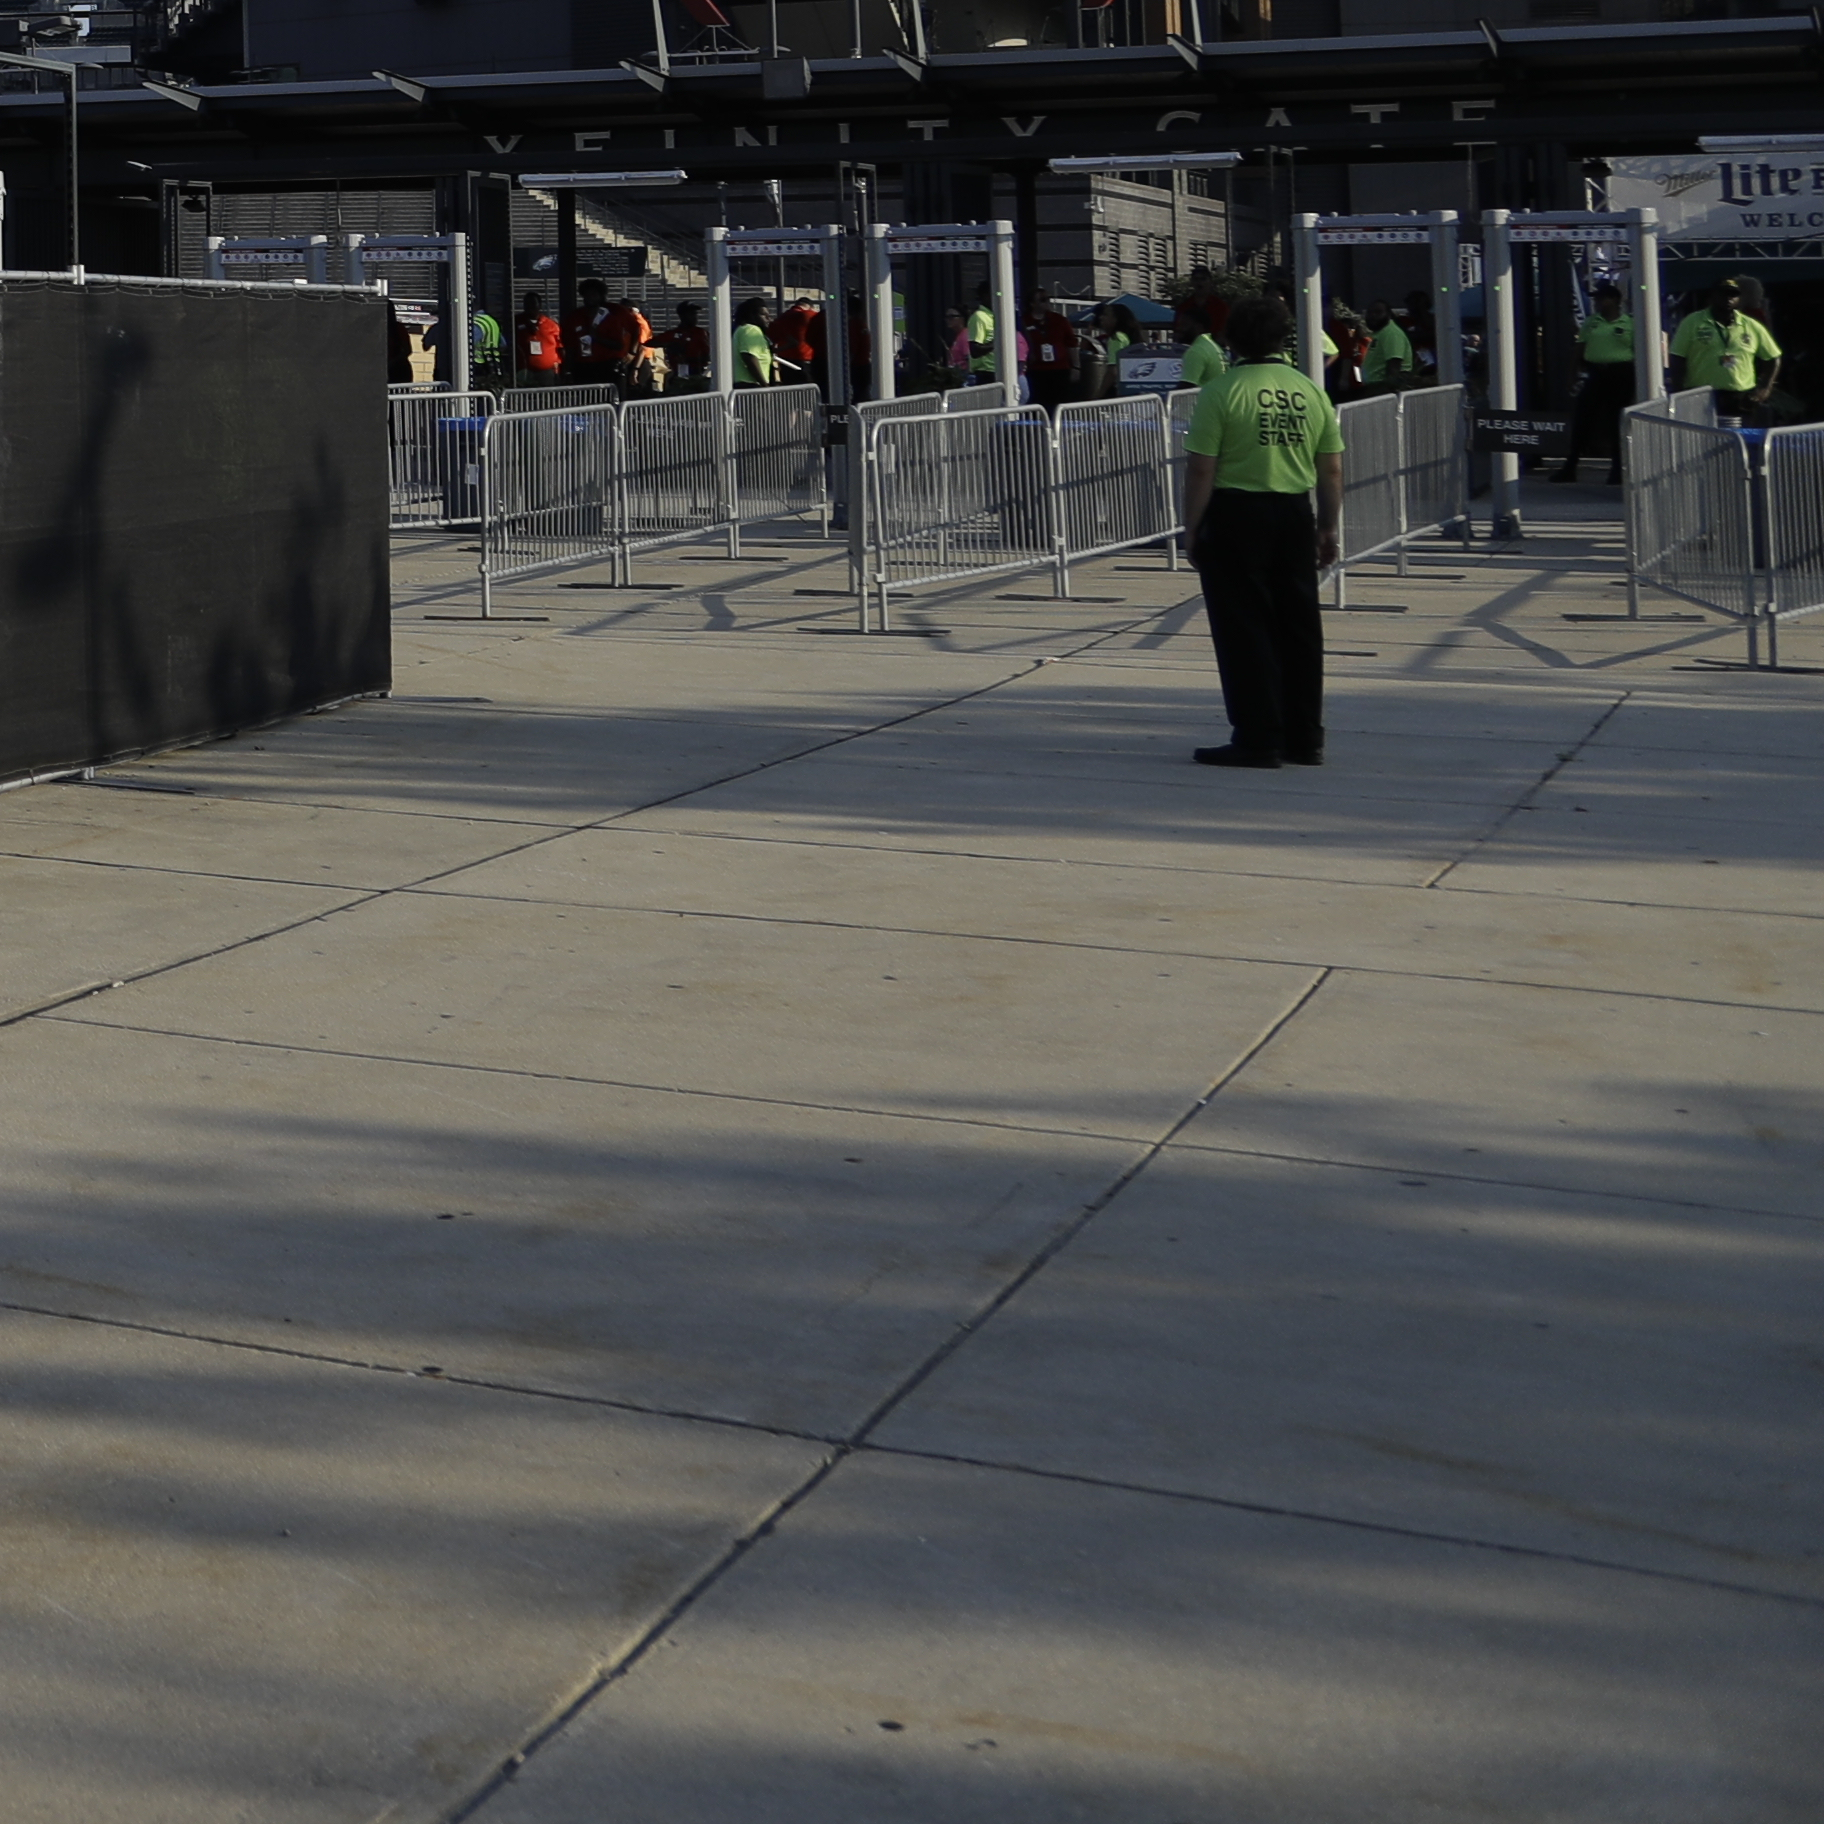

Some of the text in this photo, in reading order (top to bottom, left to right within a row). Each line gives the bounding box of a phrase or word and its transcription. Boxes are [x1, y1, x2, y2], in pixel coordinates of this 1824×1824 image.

[1716, 162, 1802, 207] Lite
[1257, 389, 1307, 412] CSC
[1258, 412, 1306, 429] EVENT
[1477, 418, 1566, 433] PLEASE WAIT
[1258, 431, 1305, 447] STAFF
[1503, 434, 1540, 446] HERE
